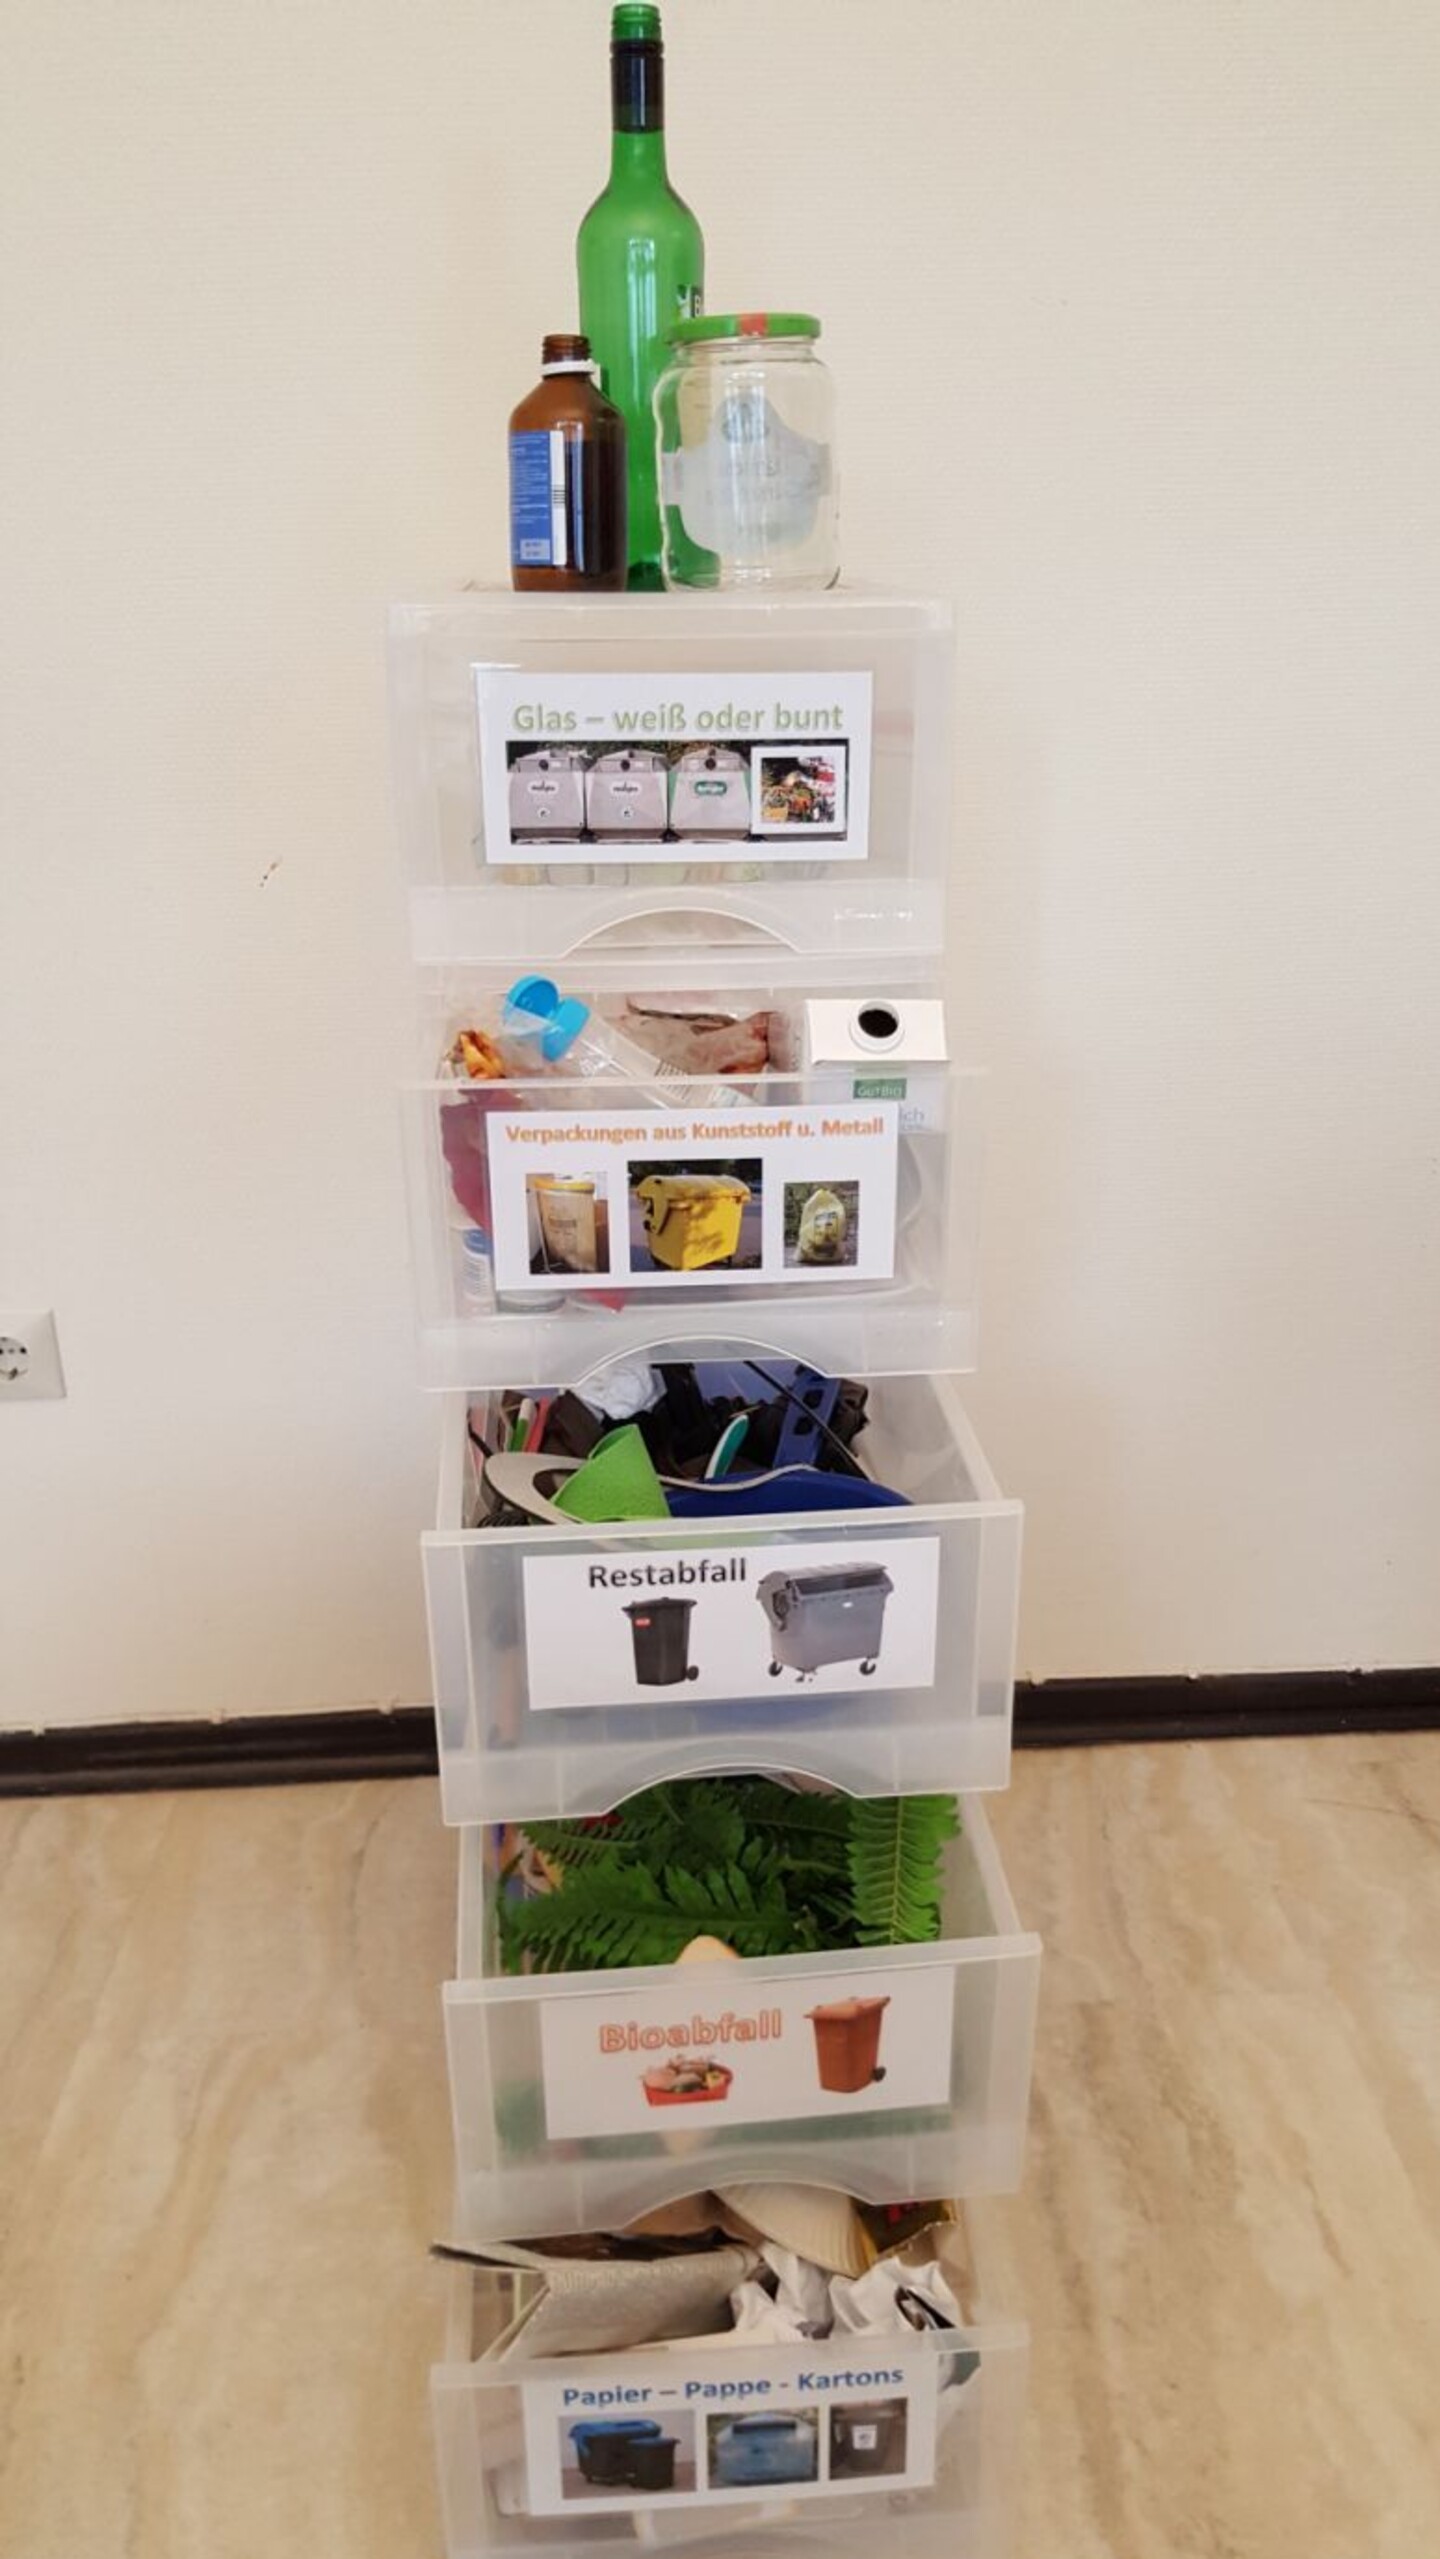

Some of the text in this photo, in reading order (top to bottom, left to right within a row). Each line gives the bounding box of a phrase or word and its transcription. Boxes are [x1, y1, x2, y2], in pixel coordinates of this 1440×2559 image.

[513, 704, 578, 731] Glas
[613, 703, 687, 731] weiß
[696, 703, 765, 730] oder
[774, 703, 843, 730] bunt
[506, 1125, 647, 1145] Verpackungen
[653, 1126, 686, 1141] aus
[691, 1119, 794, 1141] Kunststoff
[798, 1124, 815, 1138] u.
[822, 1117, 884, 1137] Metall
[588, 1557, 747, 1588] Restabfall
[599, 2009, 782, 2053] Bioabfall
[562, 2385, 652, 2408] Papier
[684, 2379, 771, 2400] Pappe
[797, 2367, 904, 2392] Kartons
